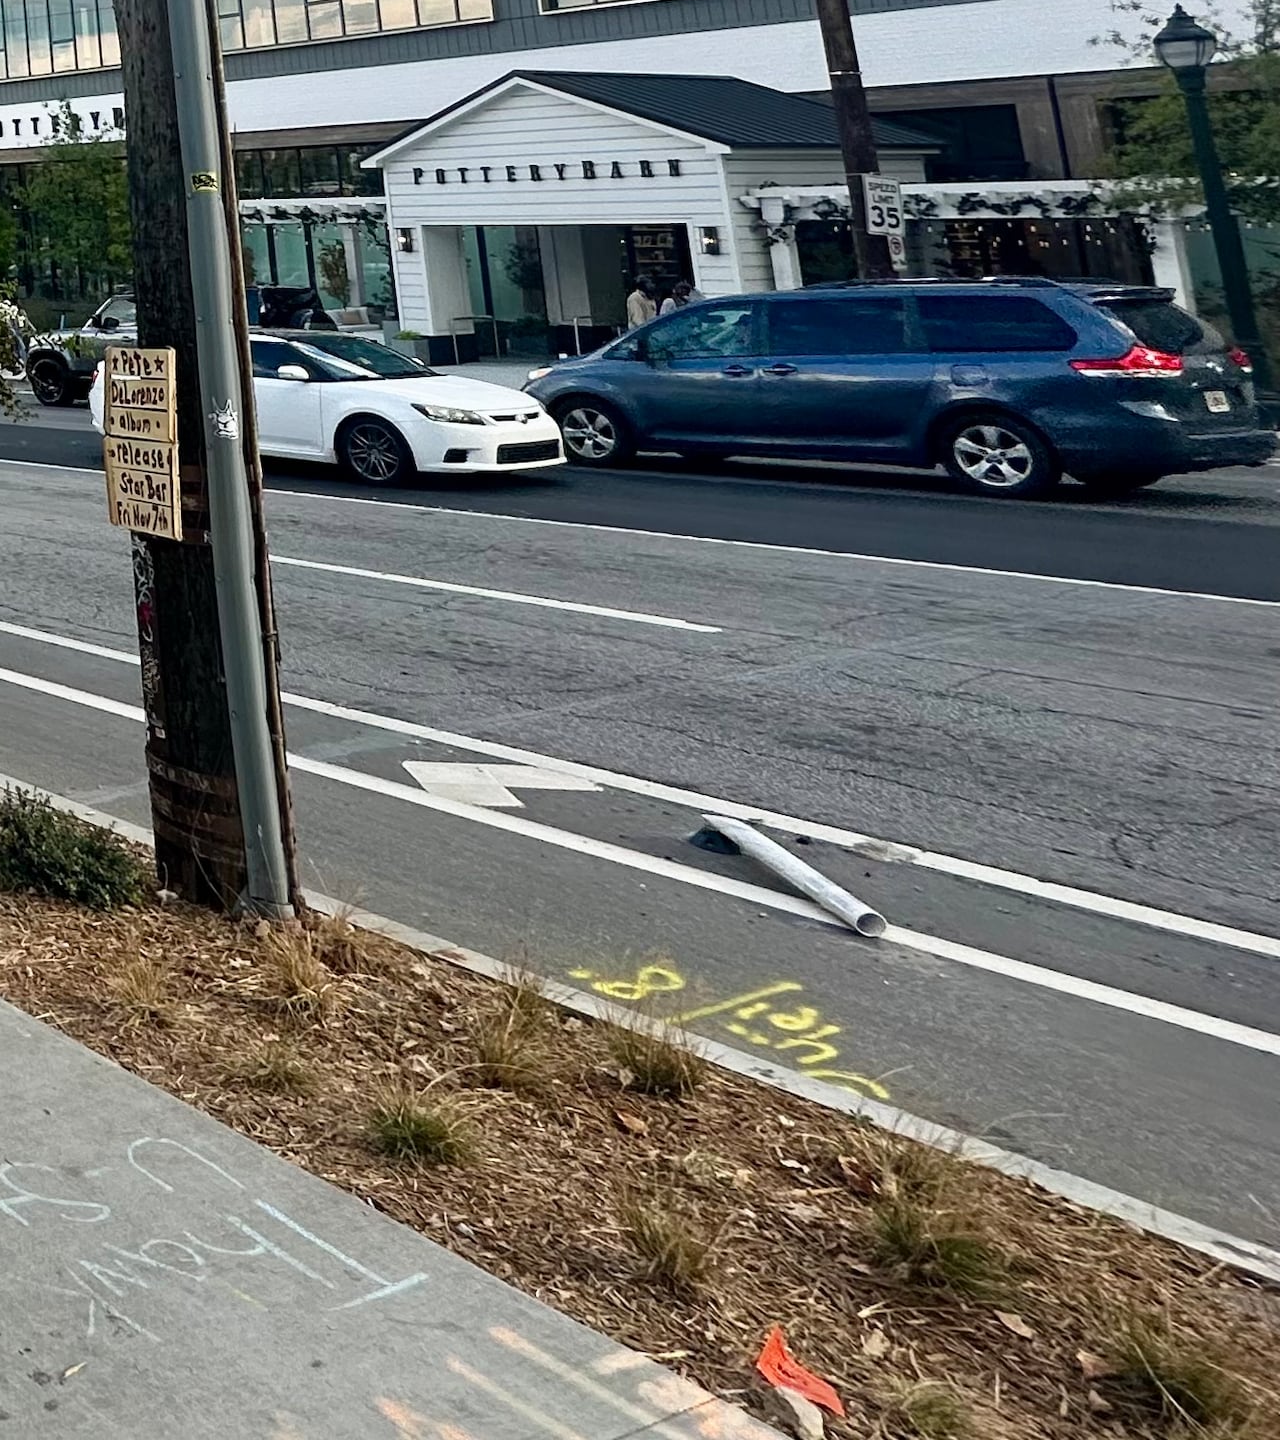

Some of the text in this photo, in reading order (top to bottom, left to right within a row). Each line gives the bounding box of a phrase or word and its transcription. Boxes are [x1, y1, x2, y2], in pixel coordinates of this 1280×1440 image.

[868, 181, 897, 193] SPEED
[873, 193, 894, 205] LIMIT
[871, 205, 900, 229] 35
[119, 411, 151, 434] album
[117, 442, 164, 469] release
[120, 472, 167, 502] Star Bar
[117, 501, 168, 531] Fri Nov 7th
